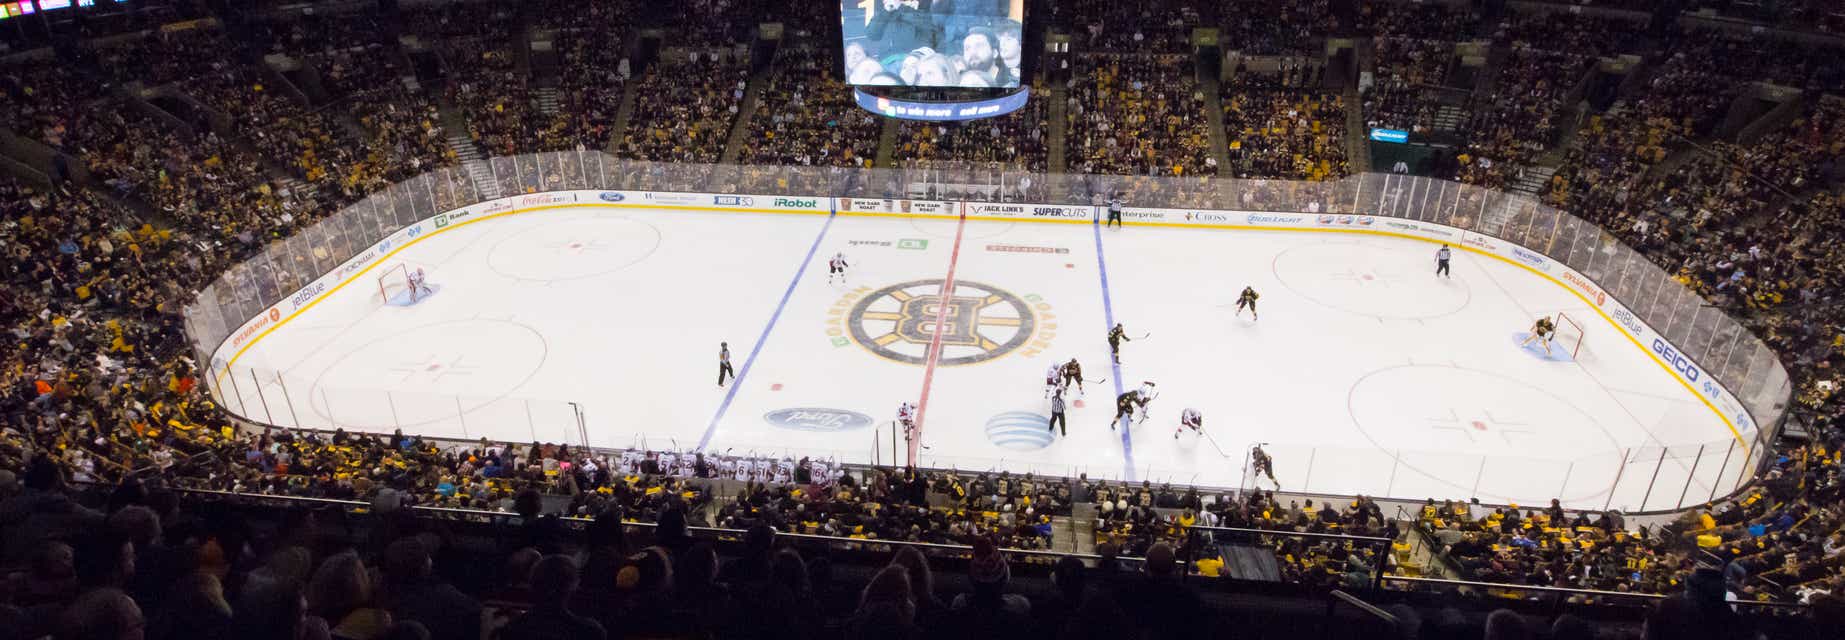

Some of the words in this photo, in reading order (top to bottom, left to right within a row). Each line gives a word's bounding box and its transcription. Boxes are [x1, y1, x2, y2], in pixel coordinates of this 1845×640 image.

[449, 210, 470, 220] Bank
[774, 198, 817, 208] iRobot
[1033, 207, 1088, 217] SUPERCUTS
[292, 282, 325, 311] jetBlue
[1563, 272, 1598, 297] SYLVANIA
[233, 316, 269, 347] SYLVANIA
[1612, 308, 1642, 336] jetBlue
[1652, 338, 1699, 383] GEICO
[738, 466, 745, 476] 6
